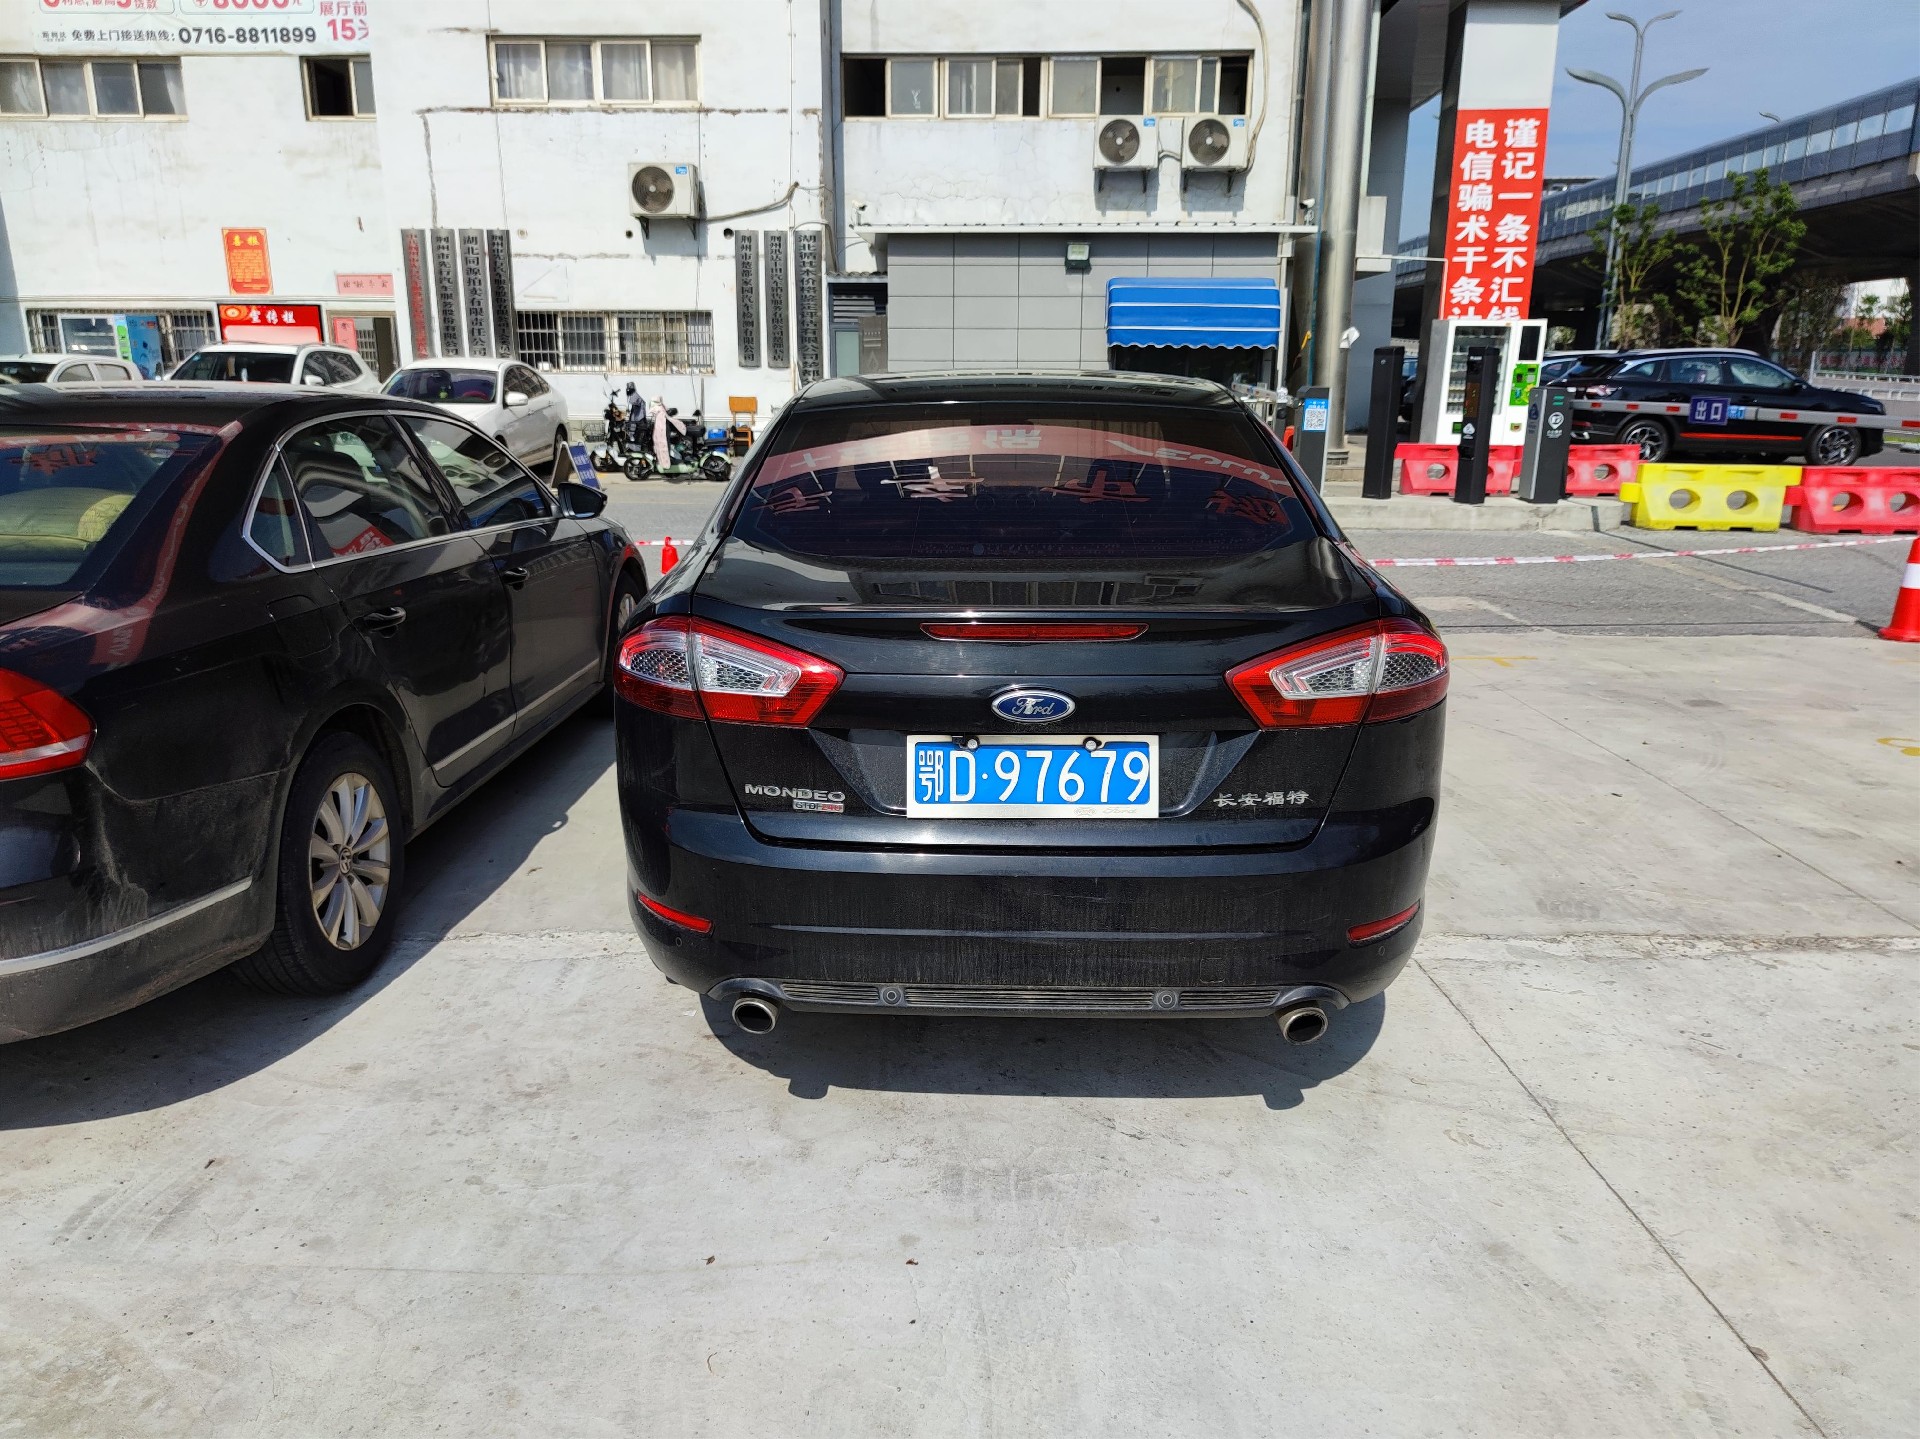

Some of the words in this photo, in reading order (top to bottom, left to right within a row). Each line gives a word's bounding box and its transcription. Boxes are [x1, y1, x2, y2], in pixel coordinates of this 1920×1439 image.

[320, 1, 367, 16] 展厅前
[178, 27, 317, 44] 0716-8811899
[463, 234, 487, 357] 湖北同源拍卖有限责任公司
[1694, 400, 1723, 421] 出口
[1011, 696, 1054, 716] Ford
[744, 783, 846, 802] MONDEO
[1212, 790, 1310, 808] 长安福特
